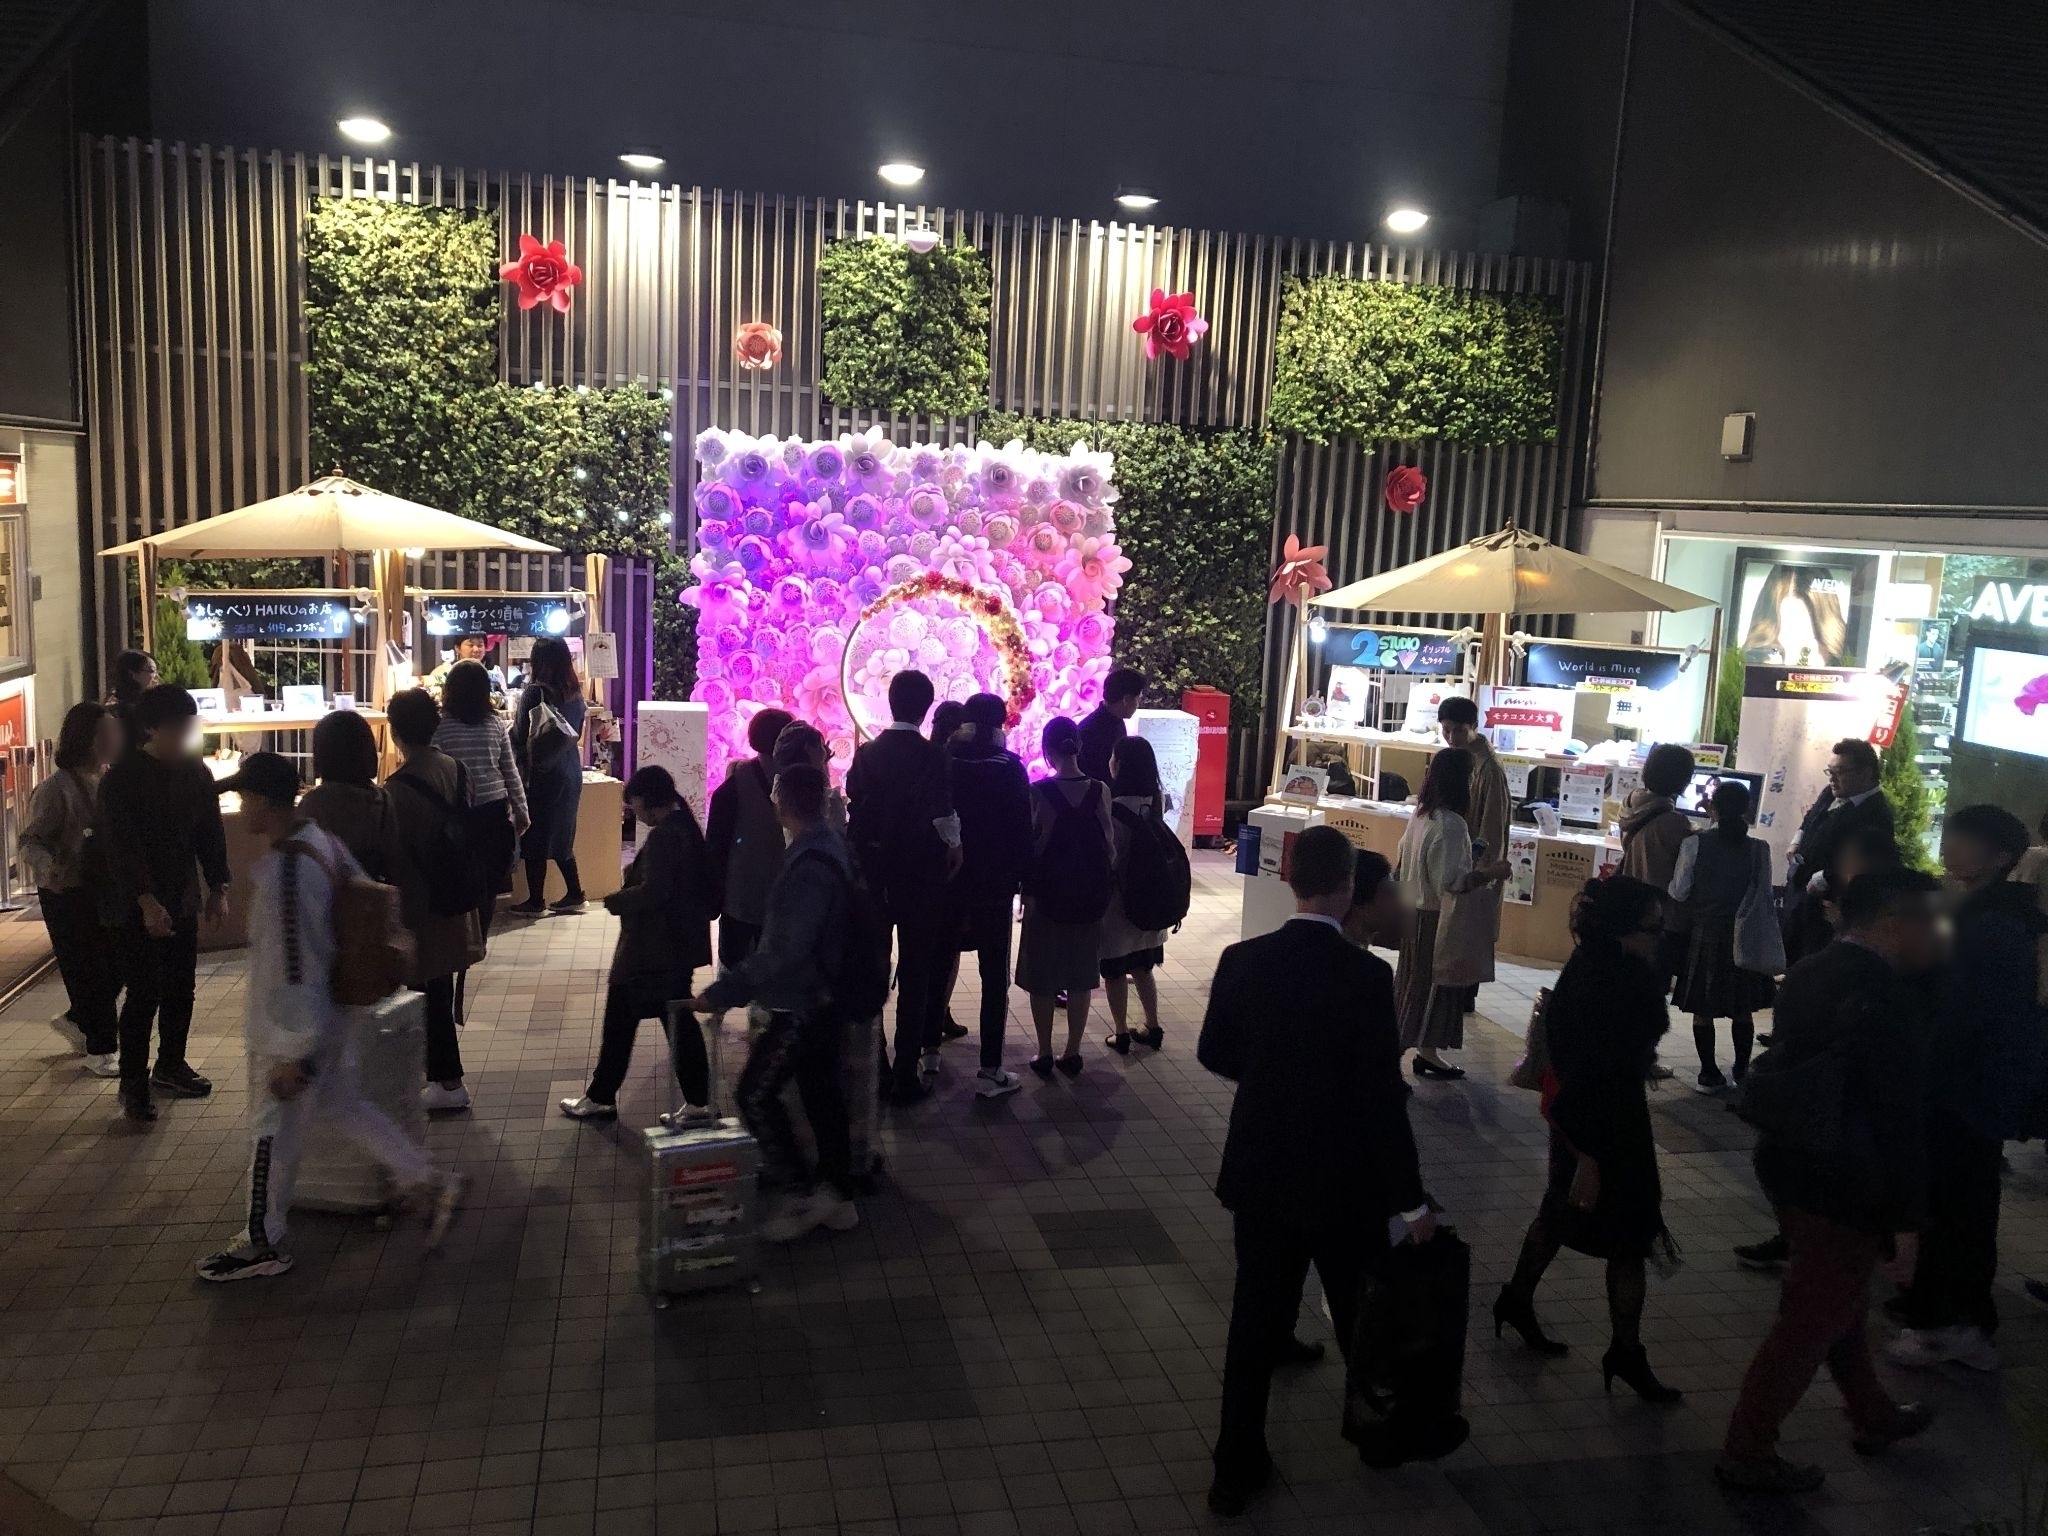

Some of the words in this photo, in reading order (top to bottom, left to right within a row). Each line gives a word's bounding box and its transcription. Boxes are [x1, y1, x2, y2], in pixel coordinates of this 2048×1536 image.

[1378, 636, 1420, 651] STUDIO
[1558, 660, 1594, 672] World
[1599, 665, 1606, 673] is
[1611, 663, 1641, 674] Mine
[1493, 712, 1555, 724] モテコスメ大賞
